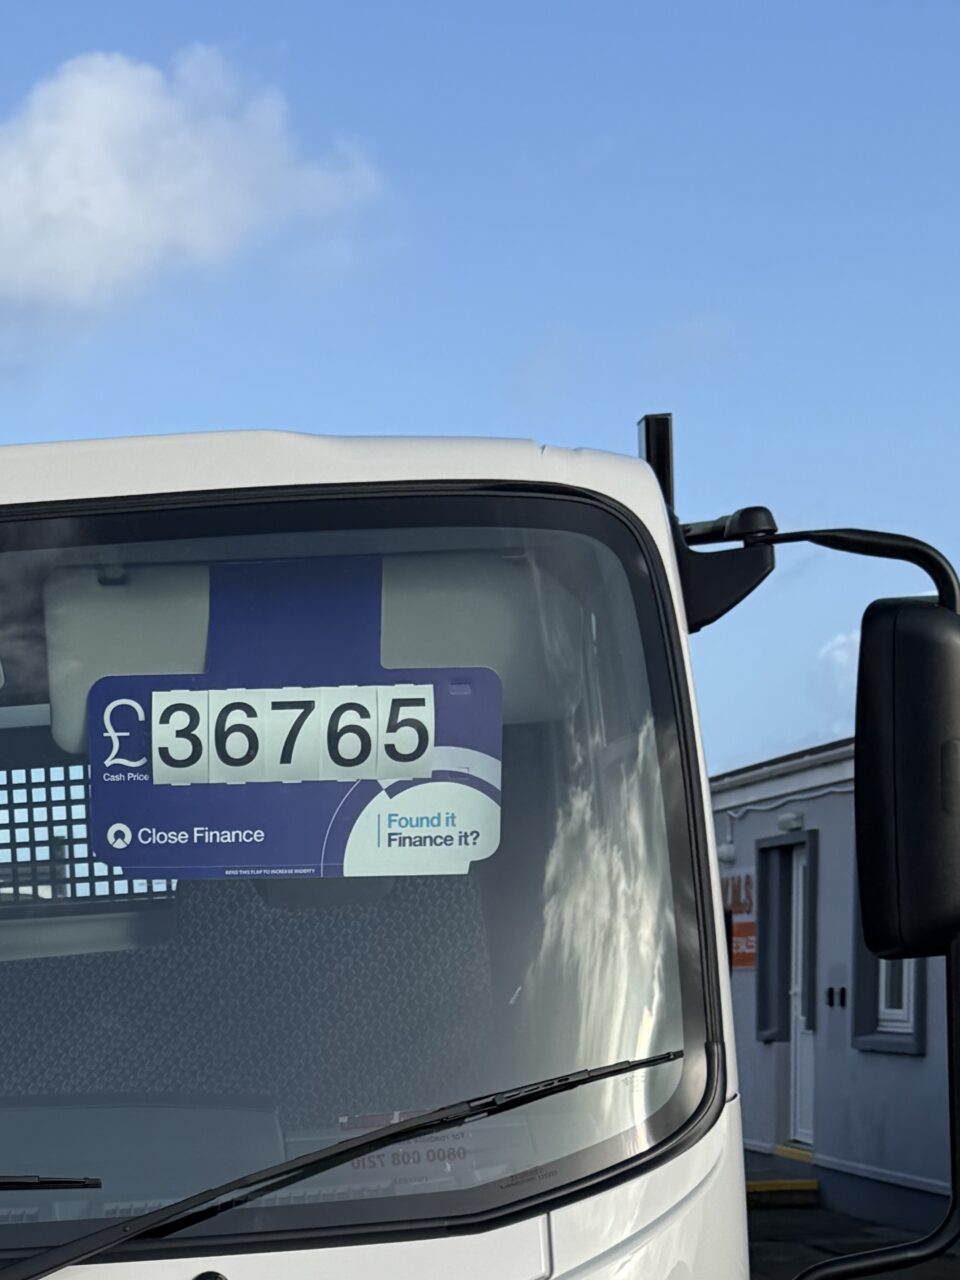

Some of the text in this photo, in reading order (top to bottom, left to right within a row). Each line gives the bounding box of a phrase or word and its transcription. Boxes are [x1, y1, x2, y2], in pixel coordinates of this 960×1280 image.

[103, 773, 150, 782] Cash Price
[387, 812, 456, 828] Found it
[138, 827, 265, 845] Close Finance
[387, 830, 480, 847] Finance it?
